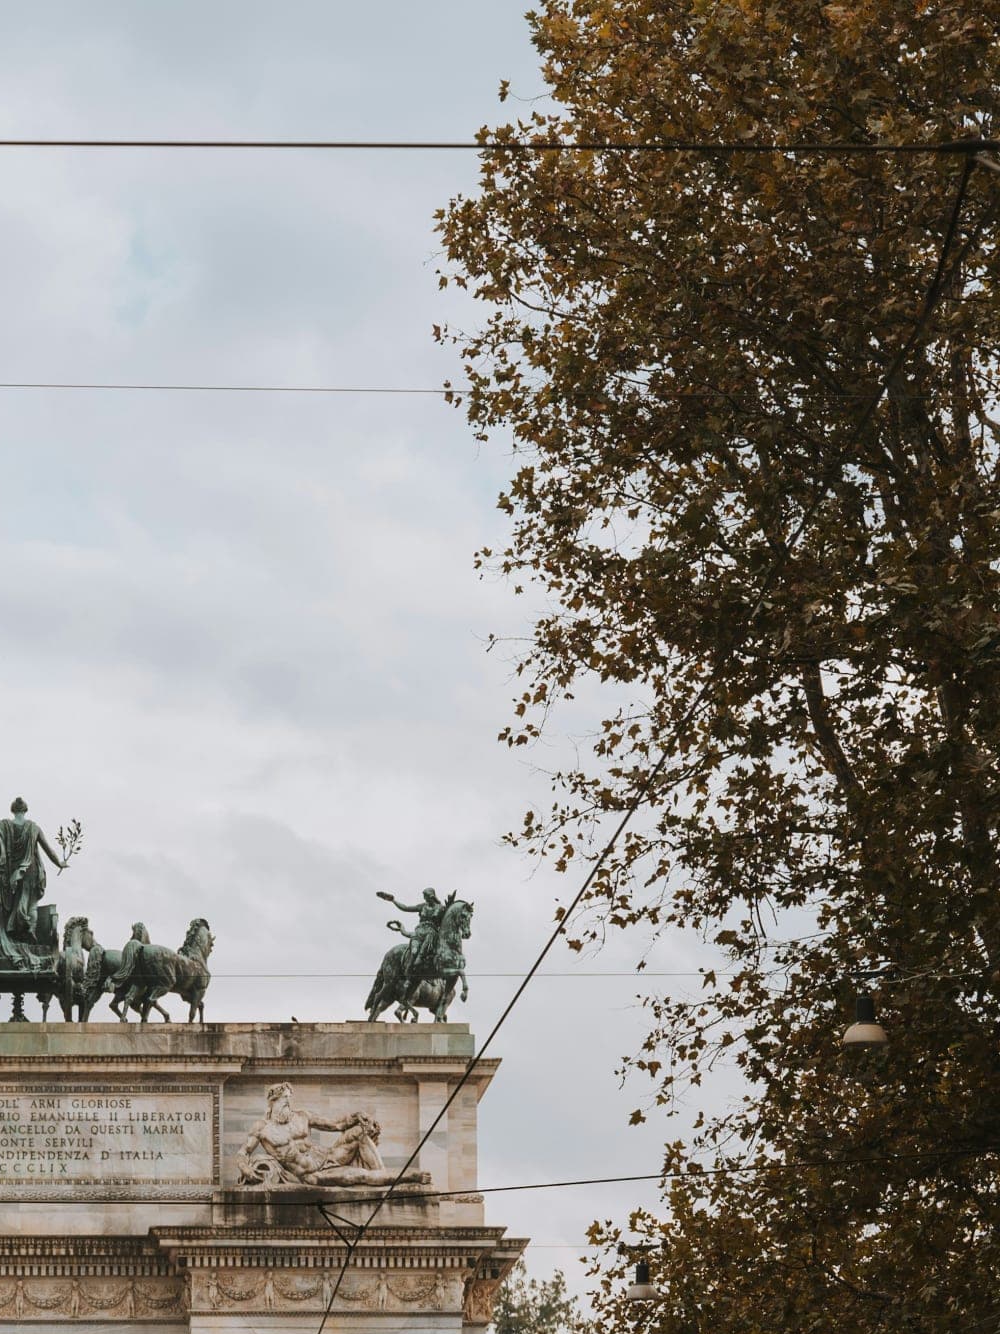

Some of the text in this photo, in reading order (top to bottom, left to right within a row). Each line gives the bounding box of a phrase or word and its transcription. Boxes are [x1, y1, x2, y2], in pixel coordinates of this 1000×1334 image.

[30, 1099, 61, 1109] ARMI
[71, 1099, 132, 1109] GLORIOSE
[30, 1112, 99, 1121] EMANUELE
[109, 1112, 117, 1121] II
[129, 1112, 206, 1121] LIBERATORI
[65, 1125, 81, 1134] DA
[91, 1124, 134, 1135] QUESTI
[144, 1125, 184, 1134] MARMI
[45, 1137, 93, 1147] SERVILI
[120, 1150, 163, 1160] ITALIA
